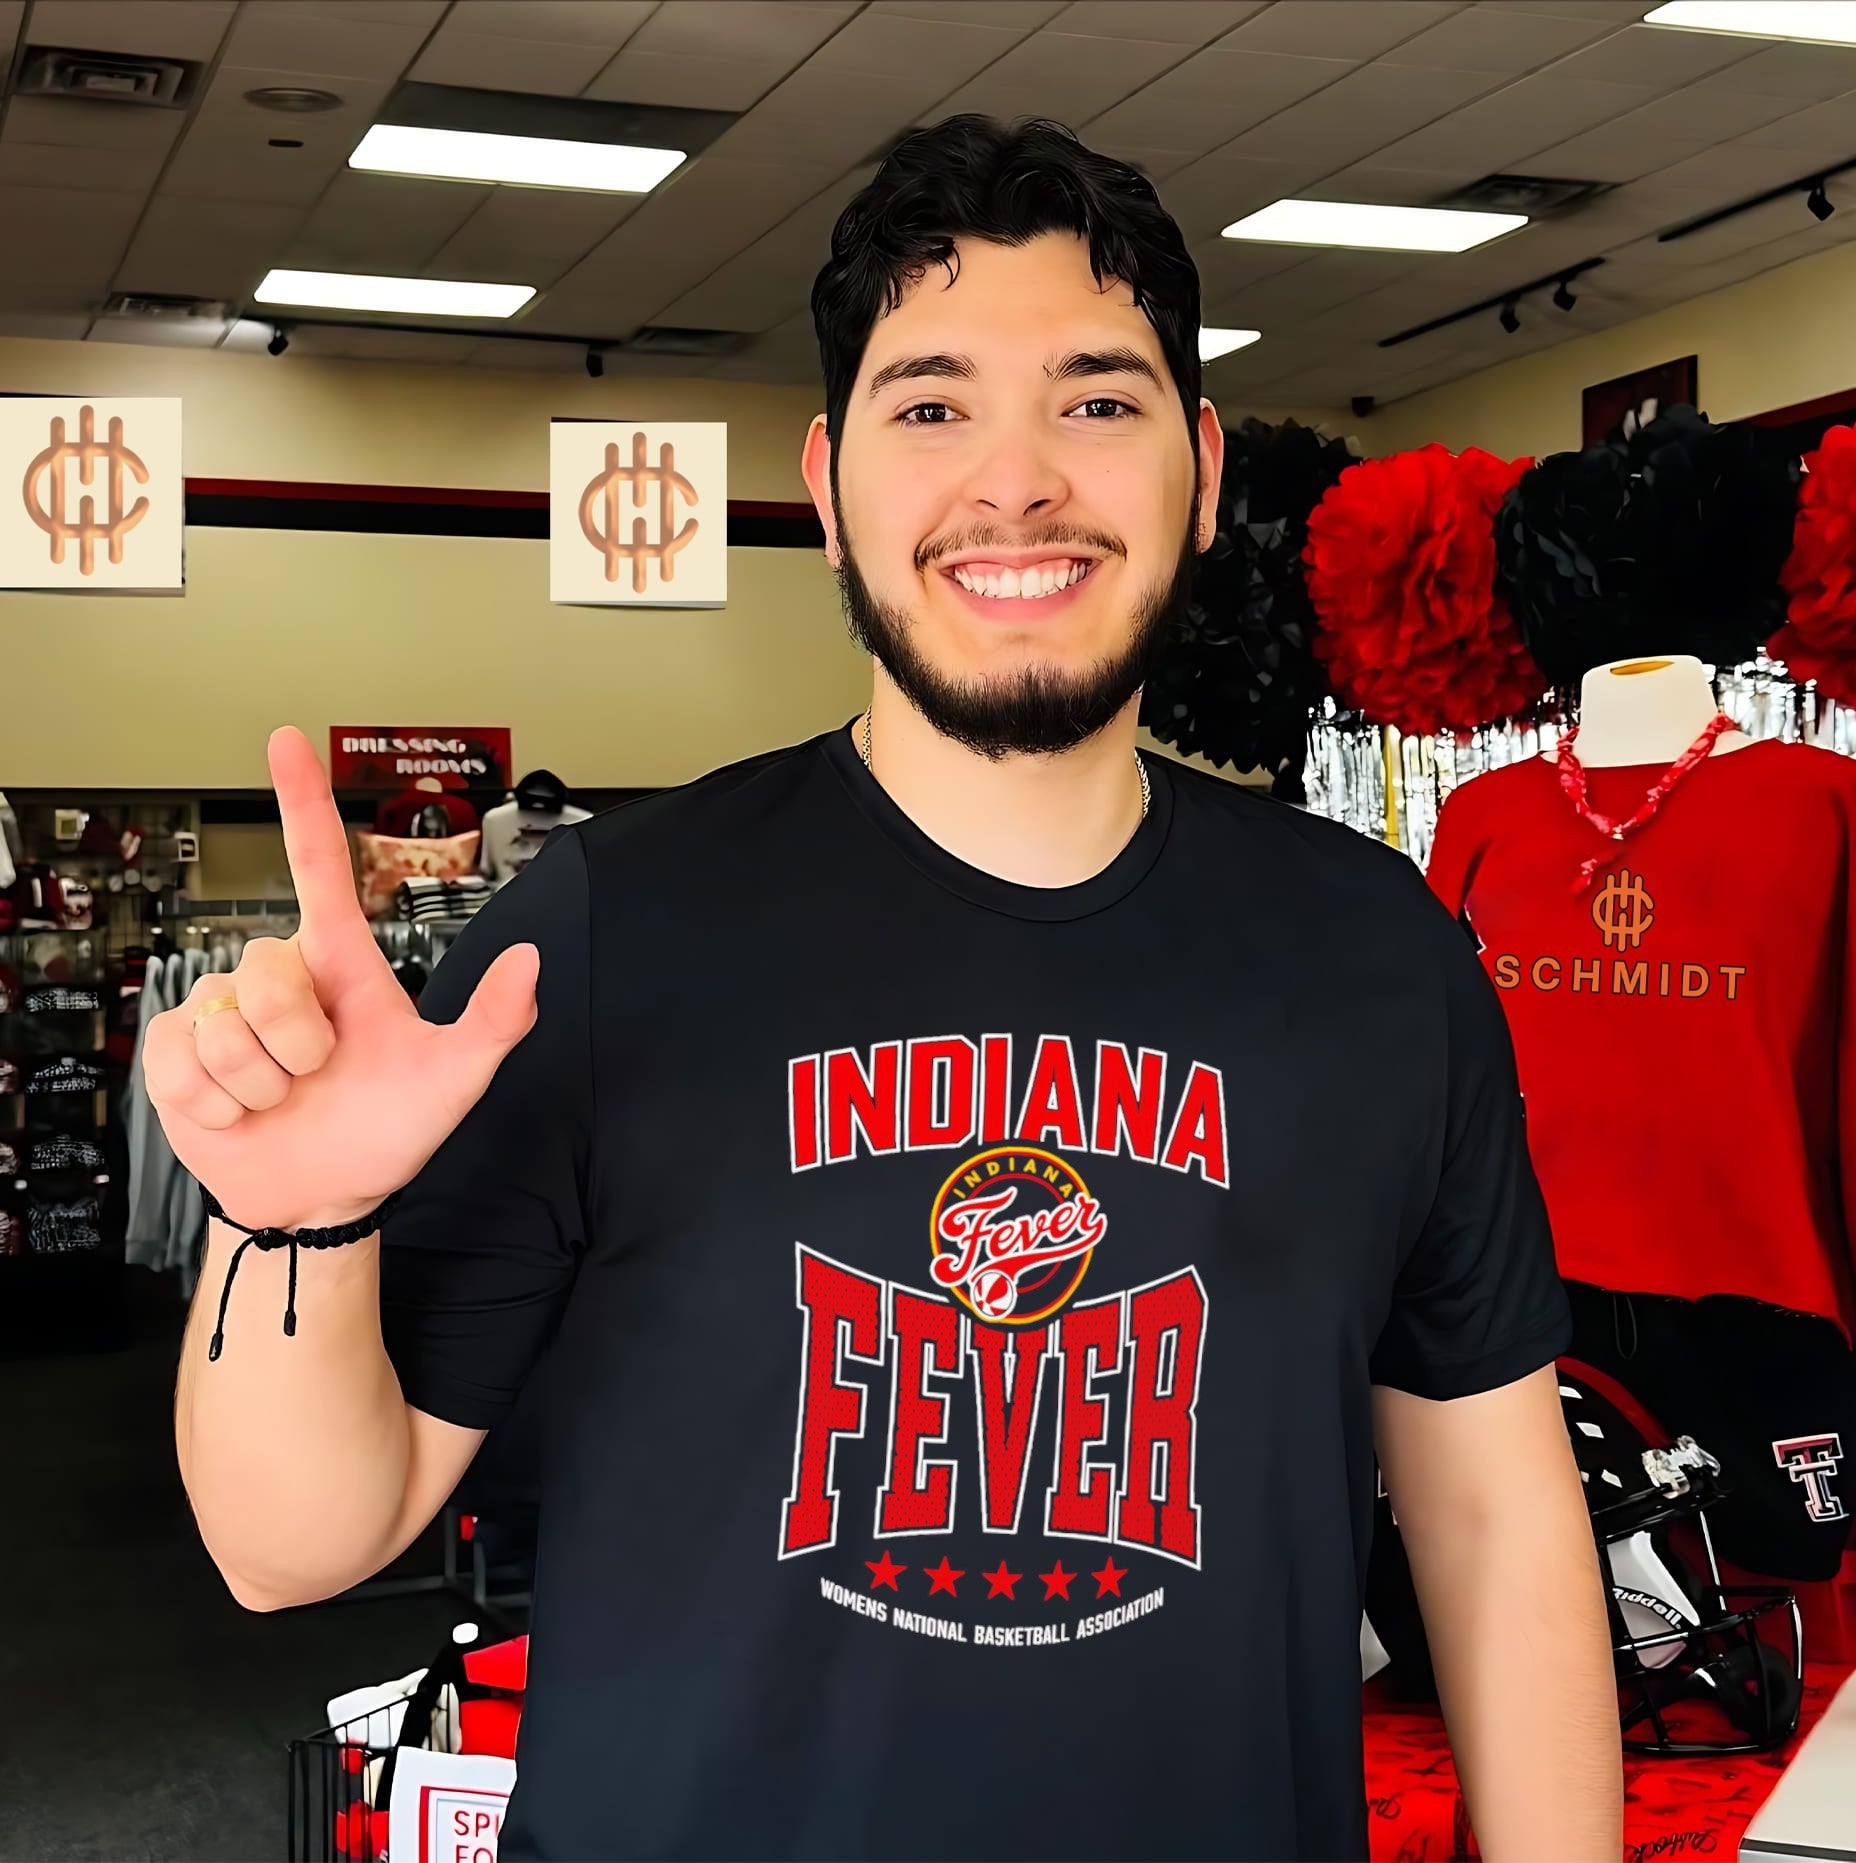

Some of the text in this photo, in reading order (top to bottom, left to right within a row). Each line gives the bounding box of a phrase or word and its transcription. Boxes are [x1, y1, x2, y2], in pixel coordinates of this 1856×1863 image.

[396, 758, 487, 776] ROOMS
[1494, 954, 1746, 1001] SCHMIDT
[788, 1032, 1230, 1190] INDIANA
[953, 1157, 1073, 1200] INDIANA
[930, 1186, 1108, 1288] Fever
[777, 1241, 1209, 1571] FEVER
[820, 1576, 1165, 1647] WOMENS NATIONAL BASKETBALL ASSOCIATION
